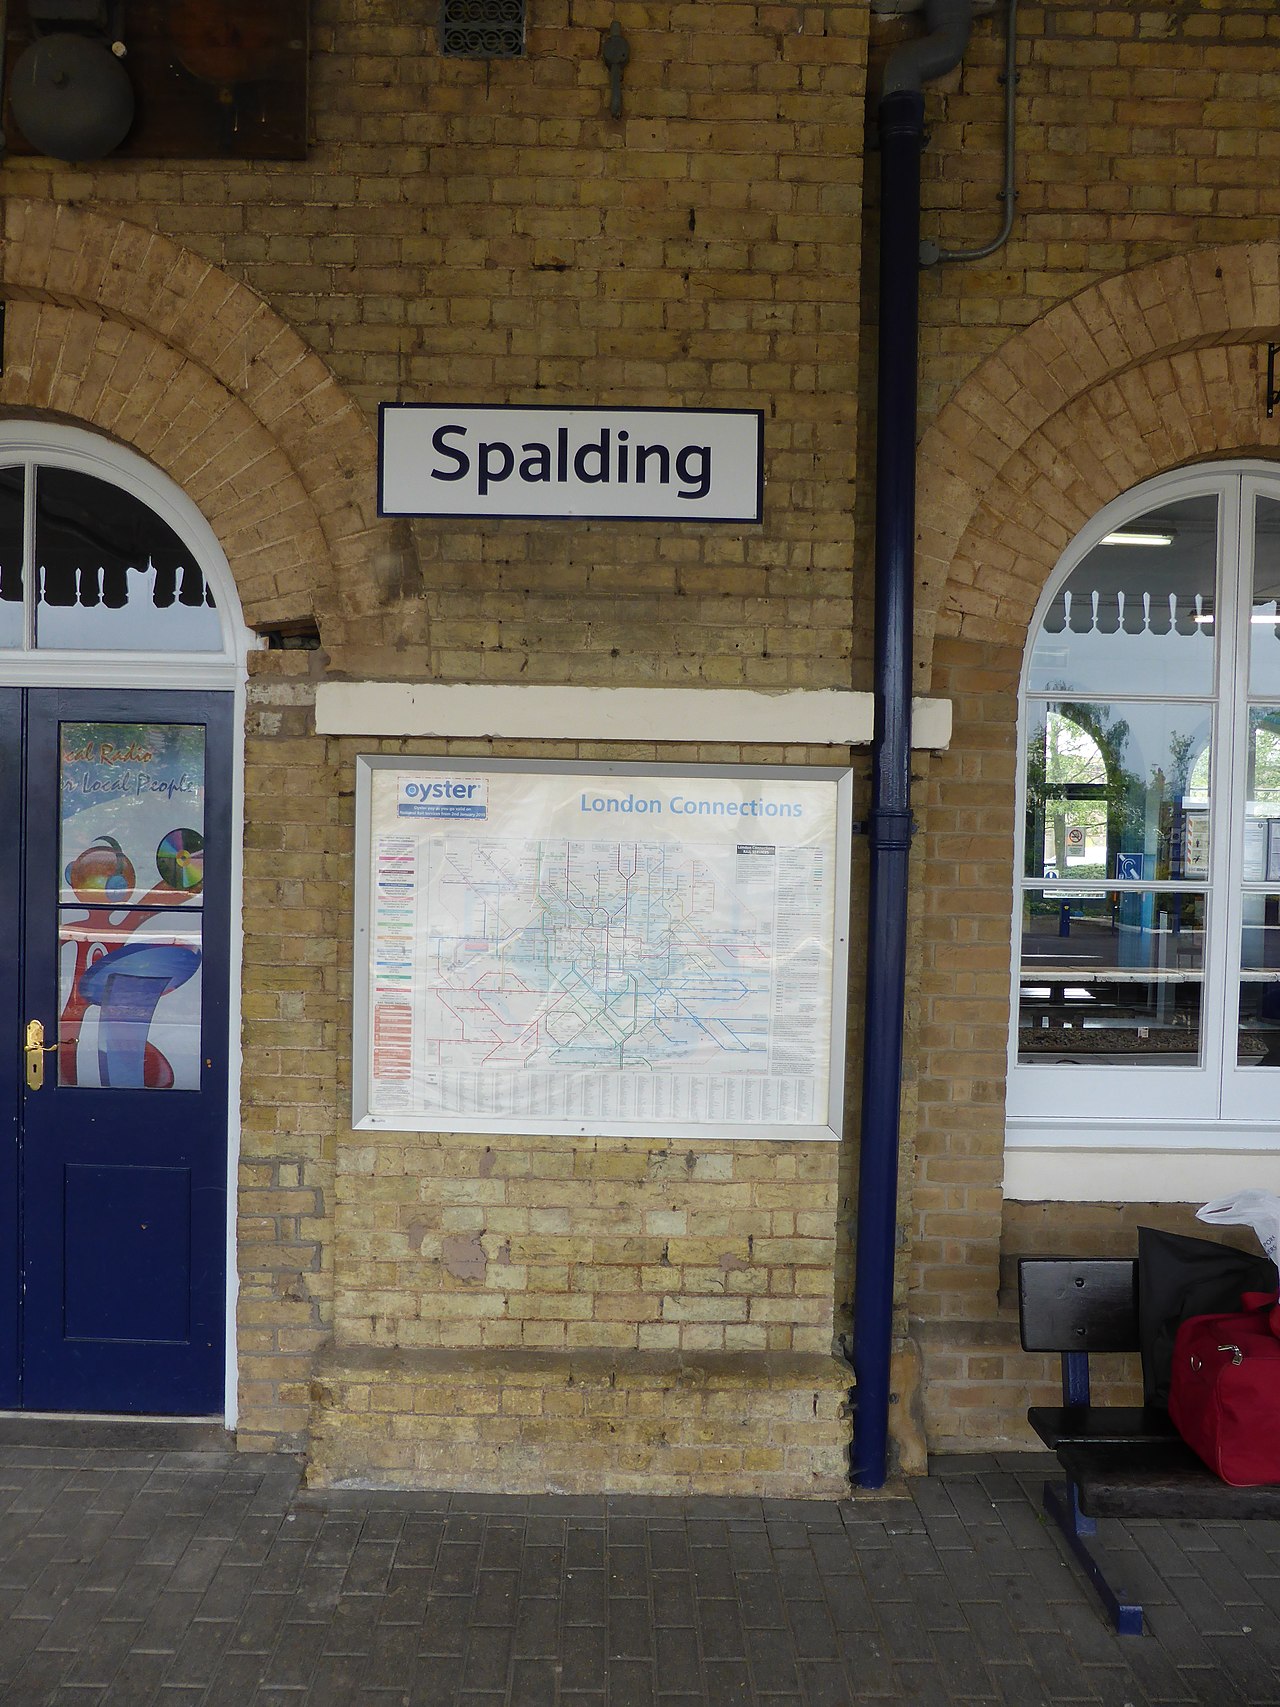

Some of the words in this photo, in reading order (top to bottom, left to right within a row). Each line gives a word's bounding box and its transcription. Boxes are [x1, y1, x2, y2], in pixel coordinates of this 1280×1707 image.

[430, 424, 711, 500] Spalding
[100, 743, 153, 766] Radio
[83, 772, 132, 793] Local
[136, 772, 194, 799] People
[405, 781, 477, 802] oyster
[581, 794, 662, 813] London
[670, 796, 802, 817] Connections
